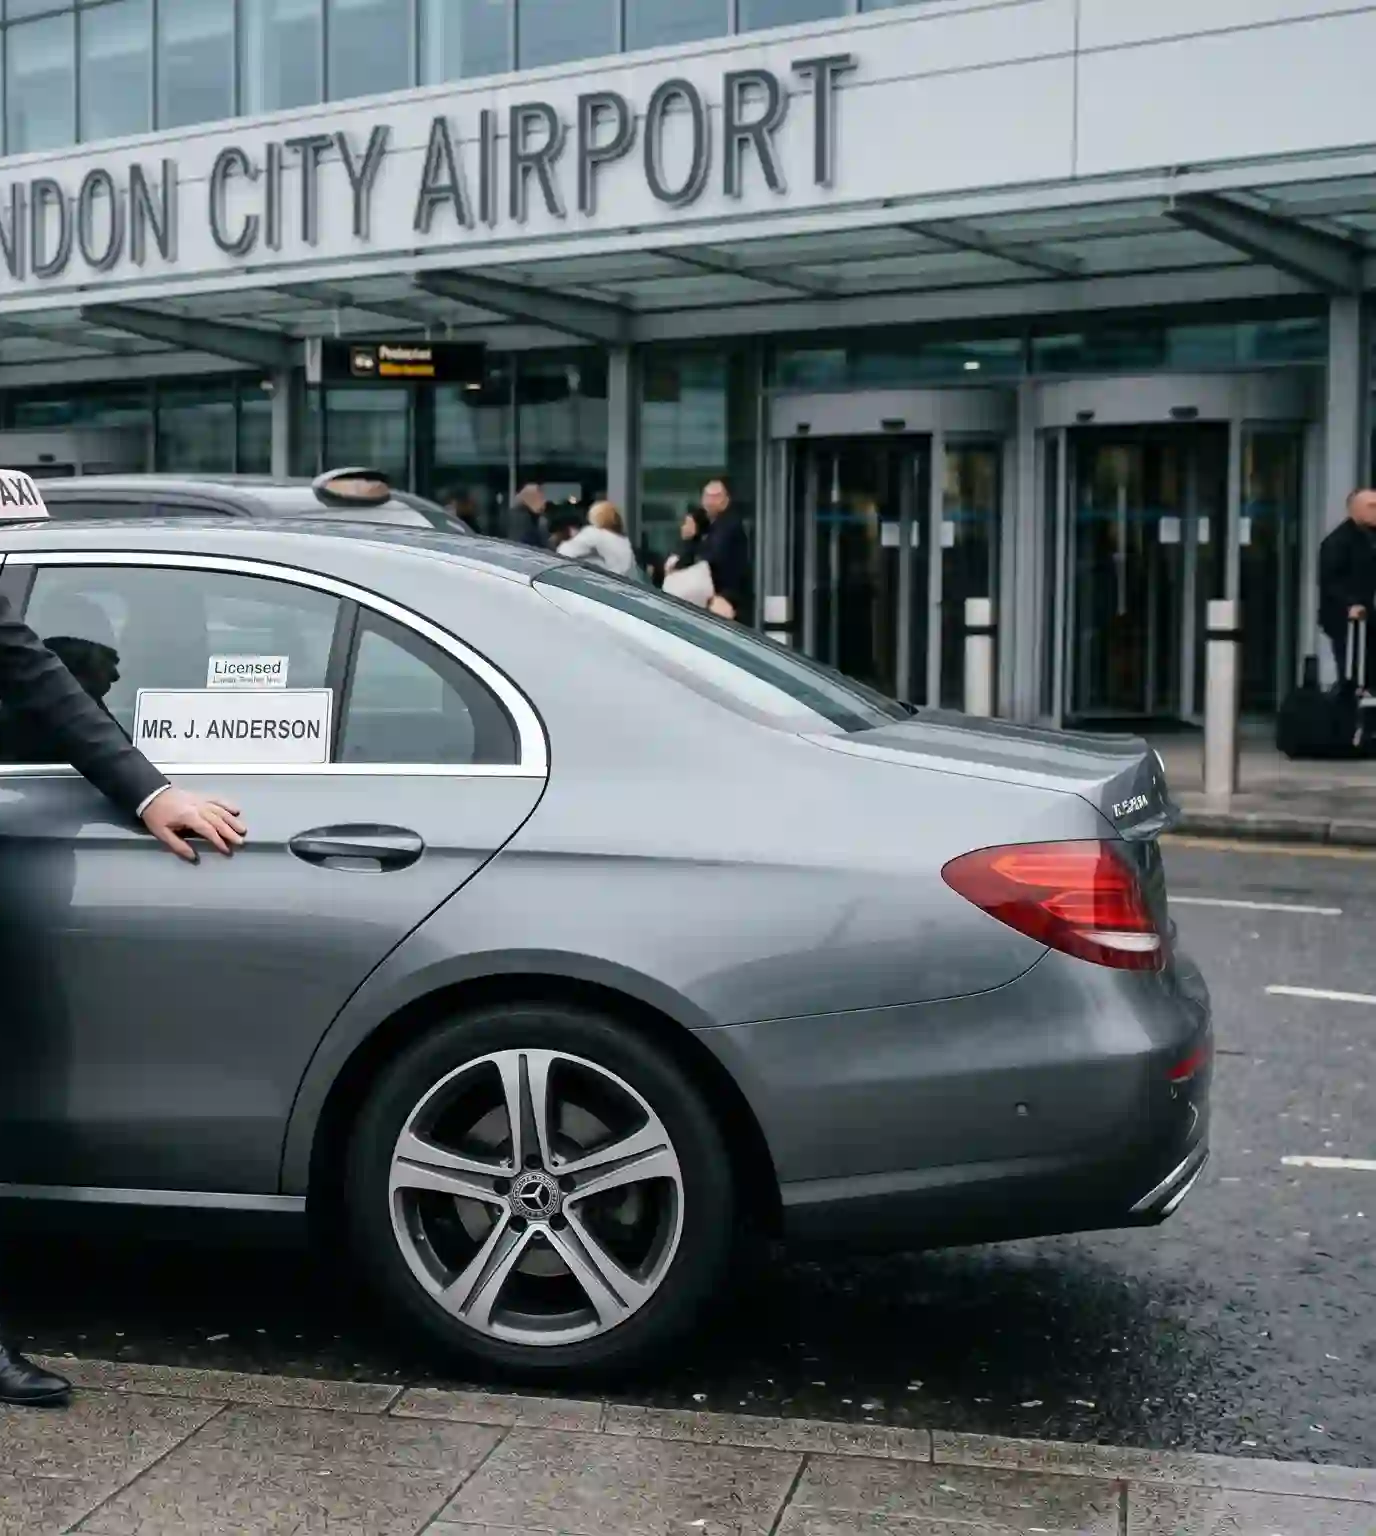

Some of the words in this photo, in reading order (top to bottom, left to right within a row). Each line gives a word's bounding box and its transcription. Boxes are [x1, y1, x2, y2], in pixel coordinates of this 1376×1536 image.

[209, 124, 392, 256] CITY
[413, 53, 858, 235] AIRPORT
[214, 660, 282, 674] Licensed
[141, 719, 177, 739] MR.
[183, 719, 200, 739] J.
[205, 719, 321, 739] ANDERSON
